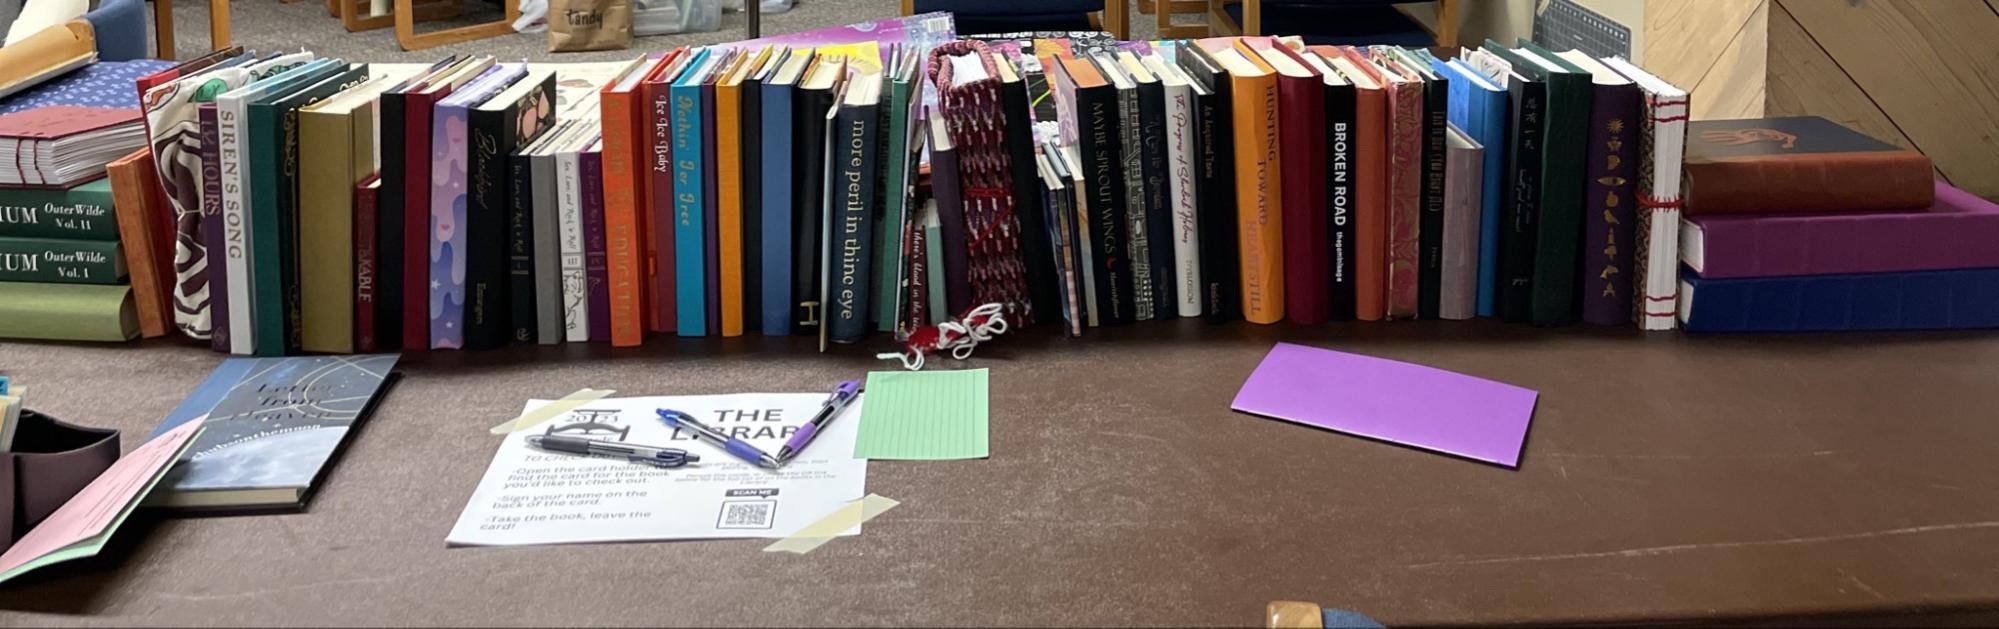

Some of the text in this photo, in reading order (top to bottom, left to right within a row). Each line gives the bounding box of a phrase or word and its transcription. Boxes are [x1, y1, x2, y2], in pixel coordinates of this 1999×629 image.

[566, 8, 604, 30] tandy
[1265, 85, 1276, 161] HUNTING
[653, 95, 669, 173] Ice Ice Baby
[851, 120, 866, 167] more
[1176, 155, 1188, 164] of
[1334, 123, 1347, 182] BROKEN
[204, 153, 221, 216] HOURS
[220, 111, 242, 260] SIREN'S SONG
[1092, 103, 1117, 255] MAYBE SPROUT WINGS
[845, 171, 864, 211] peril
[1256, 160, 1268, 224] TOWARD
[1334, 186, 1347, 226] ROAD
[56, 218, 78, 230] Vol.
[846, 216, 863, 234] in
[0, 252, 39, 272] UM
[58, 266, 81, 279] Vol.
[912, 263, 923, 286] blood
[913, 288, 921, 298] in
[838, 289, 856, 320] eye
[913, 301, 923, 314] the
[261, 398, 323, 407] from
[713, 409, 784, 423] THE
[670, 425, 802, 441] LRAR
[537, 473, 559, 481] the
[561, 472, 591, 480] card
[593, 471, 611, 479] for
[615, 471, 638, 479] the
[639, 470, 670, 478] book
[554, 465, 575, 473] the
[579, 465, 608, 473] card
[543, 479, 566, 488] like
[569, 479, 582, 487] to
[585, 477, 622, 486] check
[527, 500, 542, 508] of
[544, 499, 566, 507] the
[533, 494, 562, 502] your
[626, 490, 648, 498] the
[524, 514, 547, 522] the
[589, 511, 627, 519] leave
[630, 511, 652, 519] the
[480, 522, 517, 531] card!
